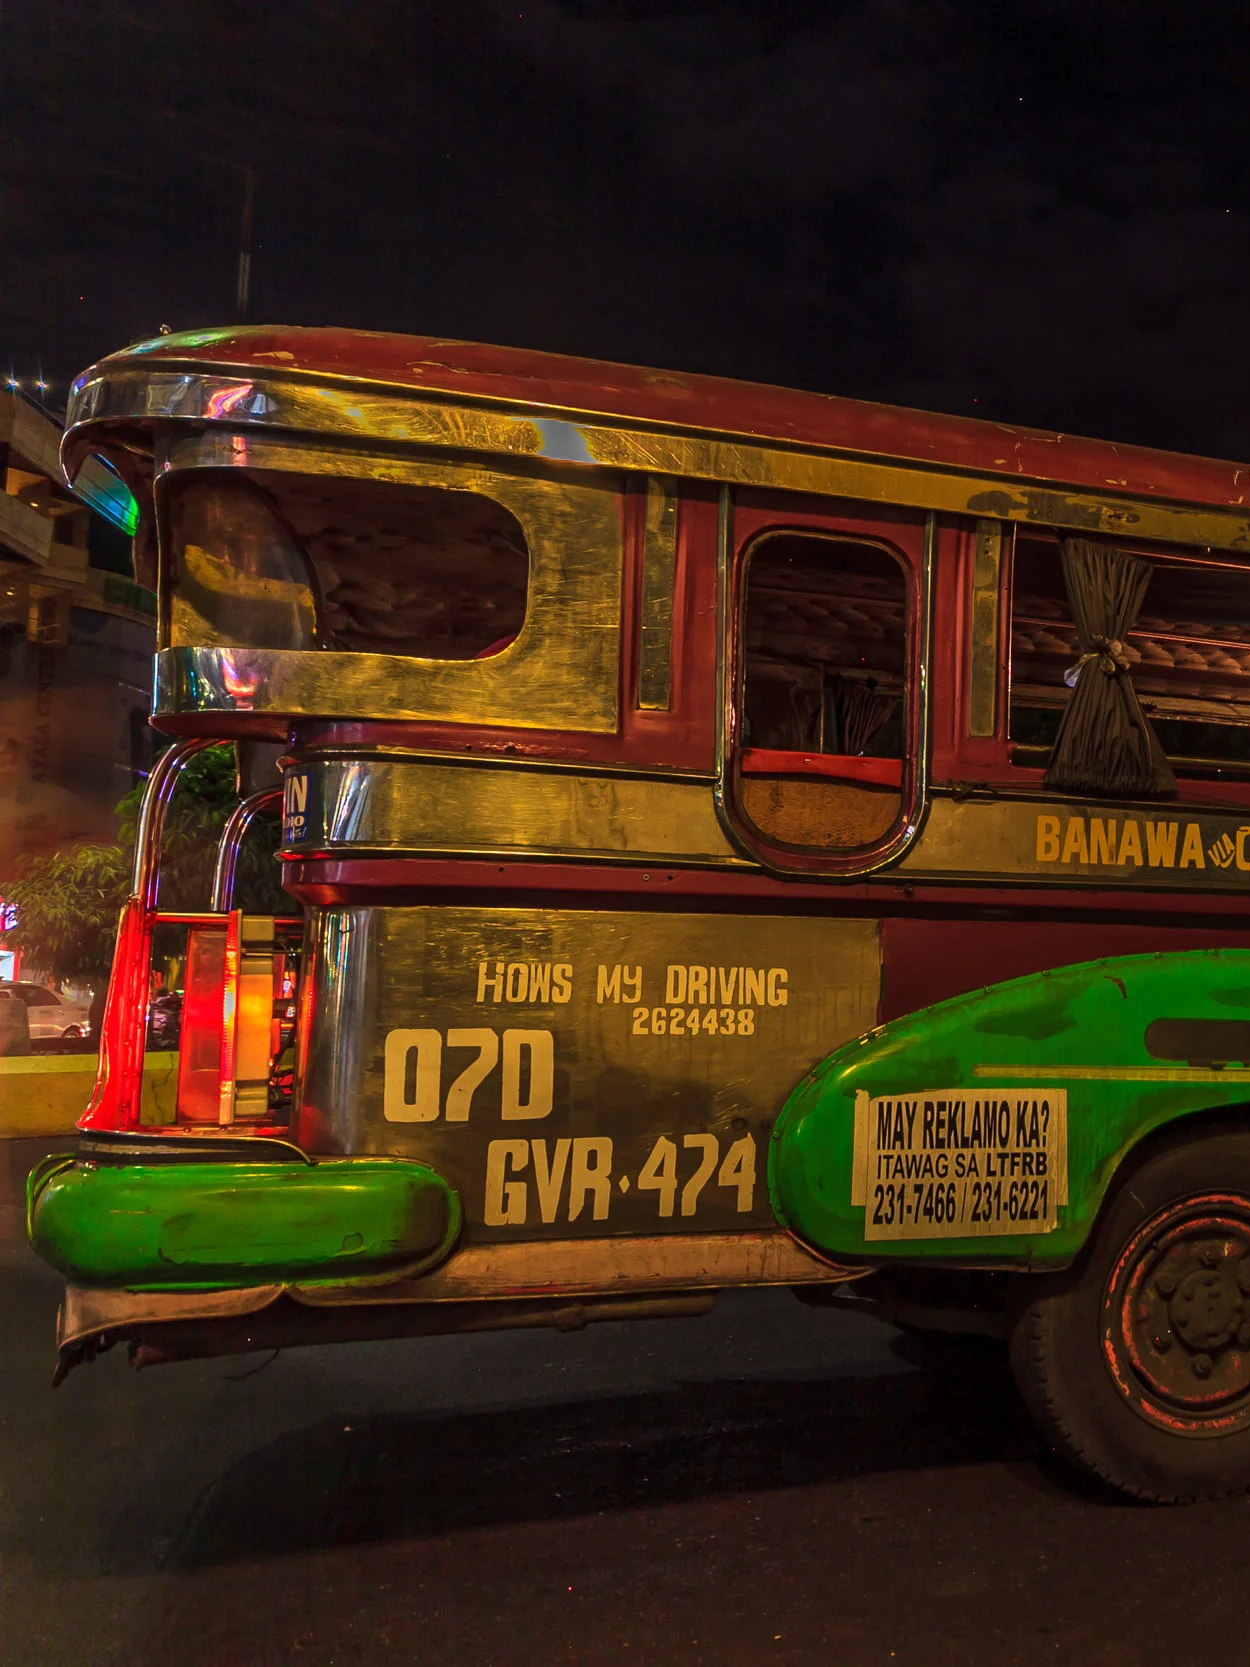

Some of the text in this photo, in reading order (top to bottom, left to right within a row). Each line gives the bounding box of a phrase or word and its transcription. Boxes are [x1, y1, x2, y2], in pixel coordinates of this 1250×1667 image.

[1036, 814, 1205, 869] BANAWA
[1207, 832, 1235, 868] VIA
[476, 962, 788, 1006] HOWS MY DRIVING
[632, 1007, 755, 1036] 2624438
[876, 1099, 1050, 1151] MAY REKLAMO KA?
[876, 1151, 1048, 1180] ITAWAG SA LTFRB
[872, 1182, 956, 1225] 231-7466
[971, 1179, 1049, 1223] 231-6221
